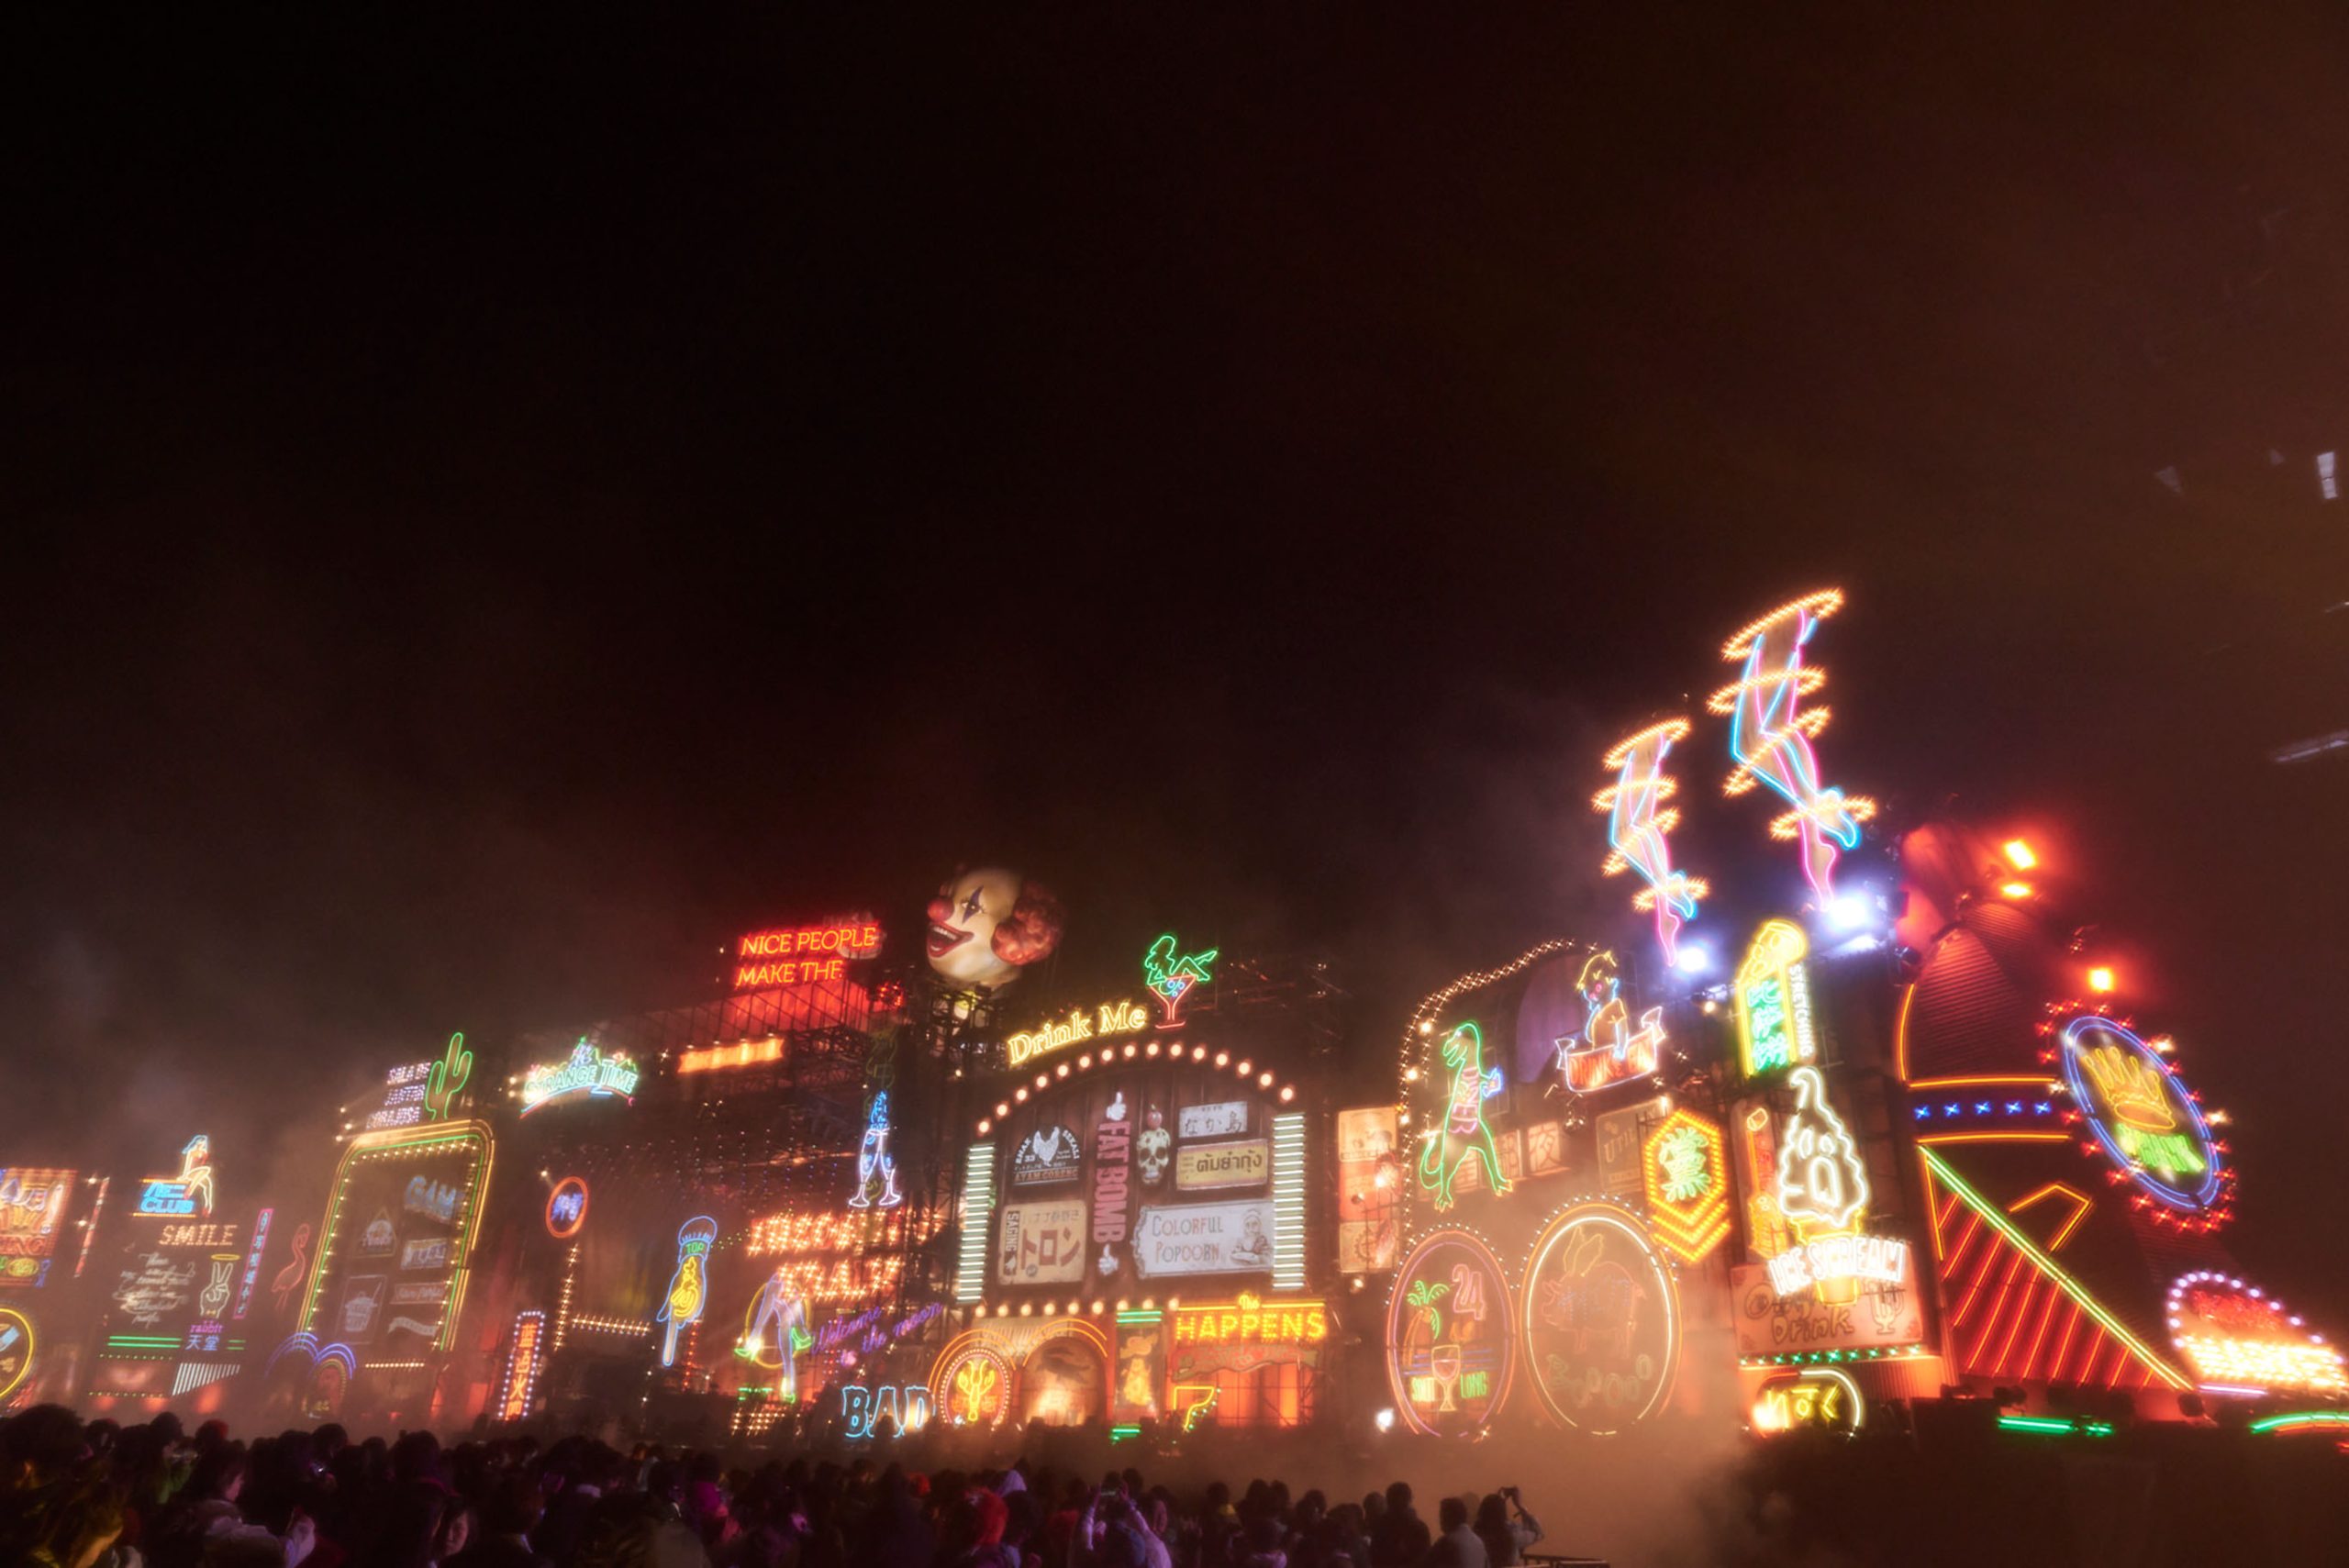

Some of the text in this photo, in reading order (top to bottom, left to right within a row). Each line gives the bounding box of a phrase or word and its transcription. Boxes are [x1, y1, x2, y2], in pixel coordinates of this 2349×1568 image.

[740, 927, 876, 956] NICE PEOPLE
[736, 962, 795, 987] MAKE
[1008, 1001, 1147, 1064] Drink Me
[601, 1058, 639, 1095] TIME
[1097, 1120, 1130, 1163] FAT
[139, 1196, 195, 1213] CLUB
[1093, 1166, 1129, 1242] BOMB
[158, 1224, 239, 1246] SMILE
[1152, 1215, 1224, 1237] COLORFUL
[685, 1241, 706, 1255] TOP
[1767, 1235, 1906, 1296] ICE SCREAM
[1452, 1263, 1486, 1321] 24
[1174, 1311, 1328, 1341] HAPPENS
[185, 1334, 220, 1351] 天堂
[841, 1385, 937, 1438] BAD
